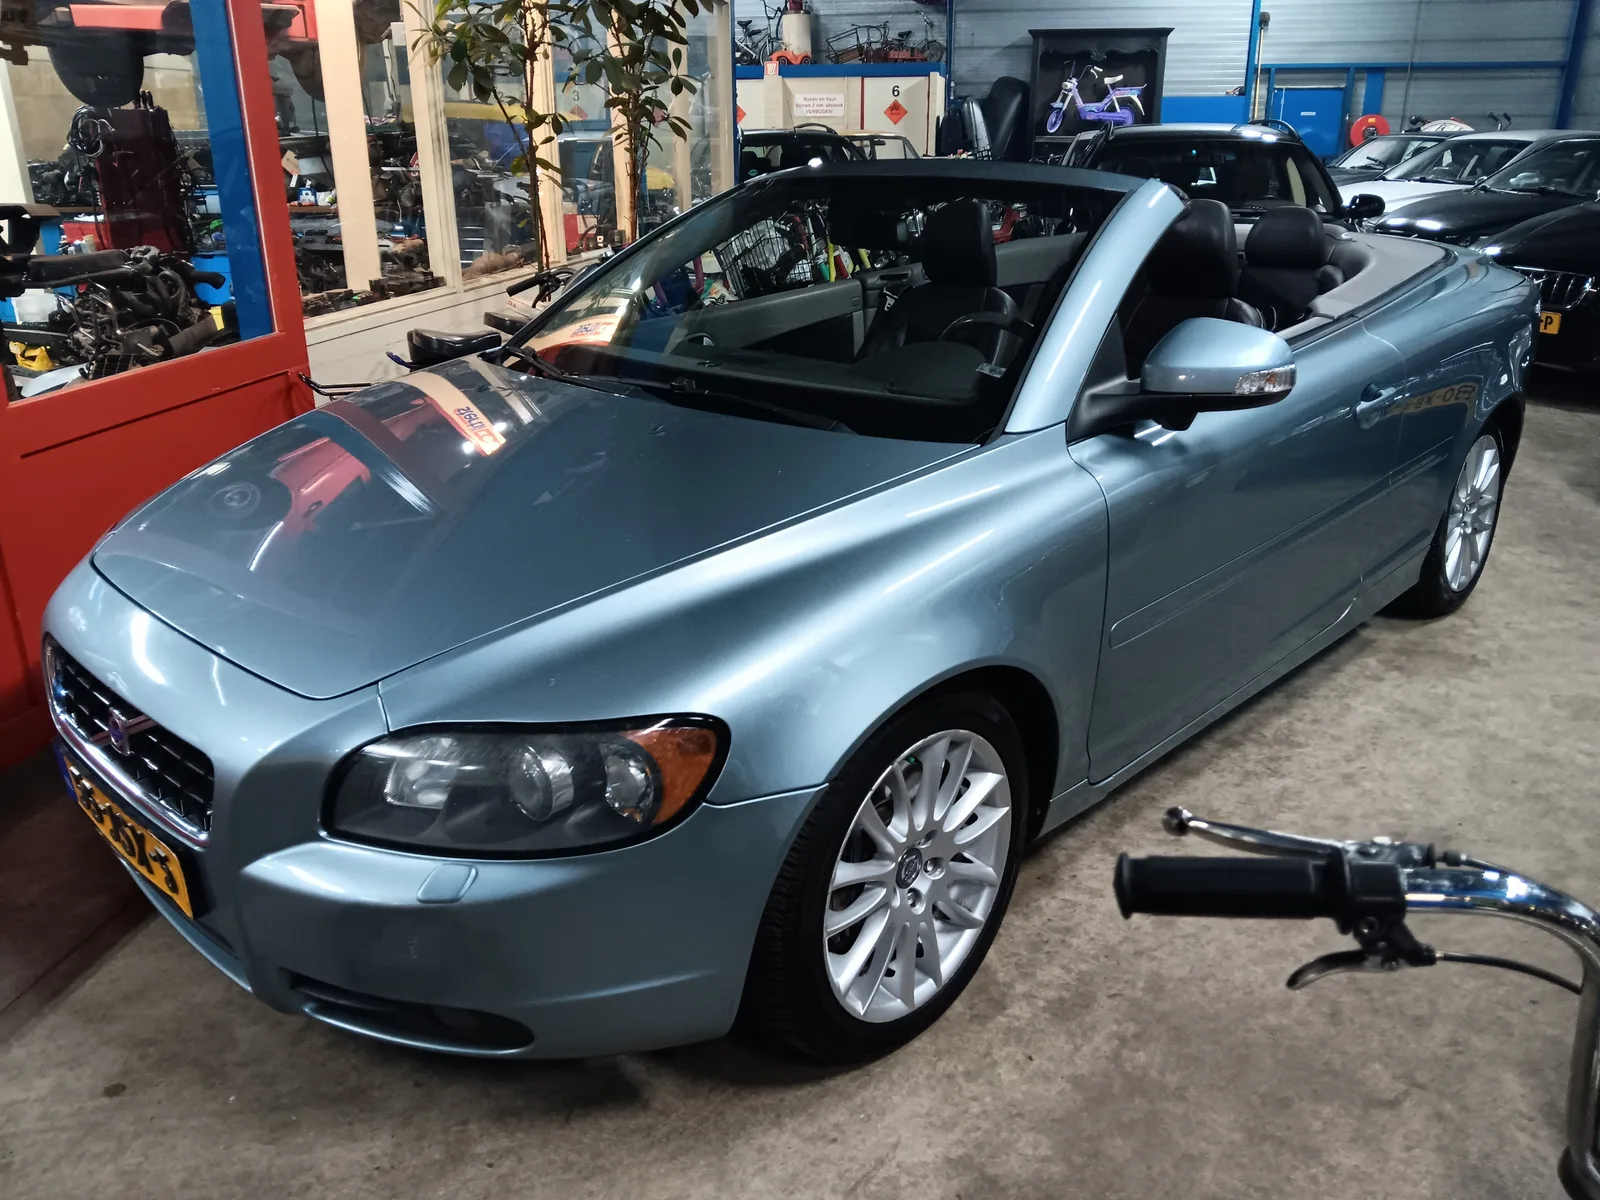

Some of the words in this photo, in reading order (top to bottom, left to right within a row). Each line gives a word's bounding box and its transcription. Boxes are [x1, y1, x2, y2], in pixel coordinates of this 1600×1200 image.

[572, 90, 580, 101] 3
[651, 89, 658, 100] 4
[892, 85, 900, 97] 6
